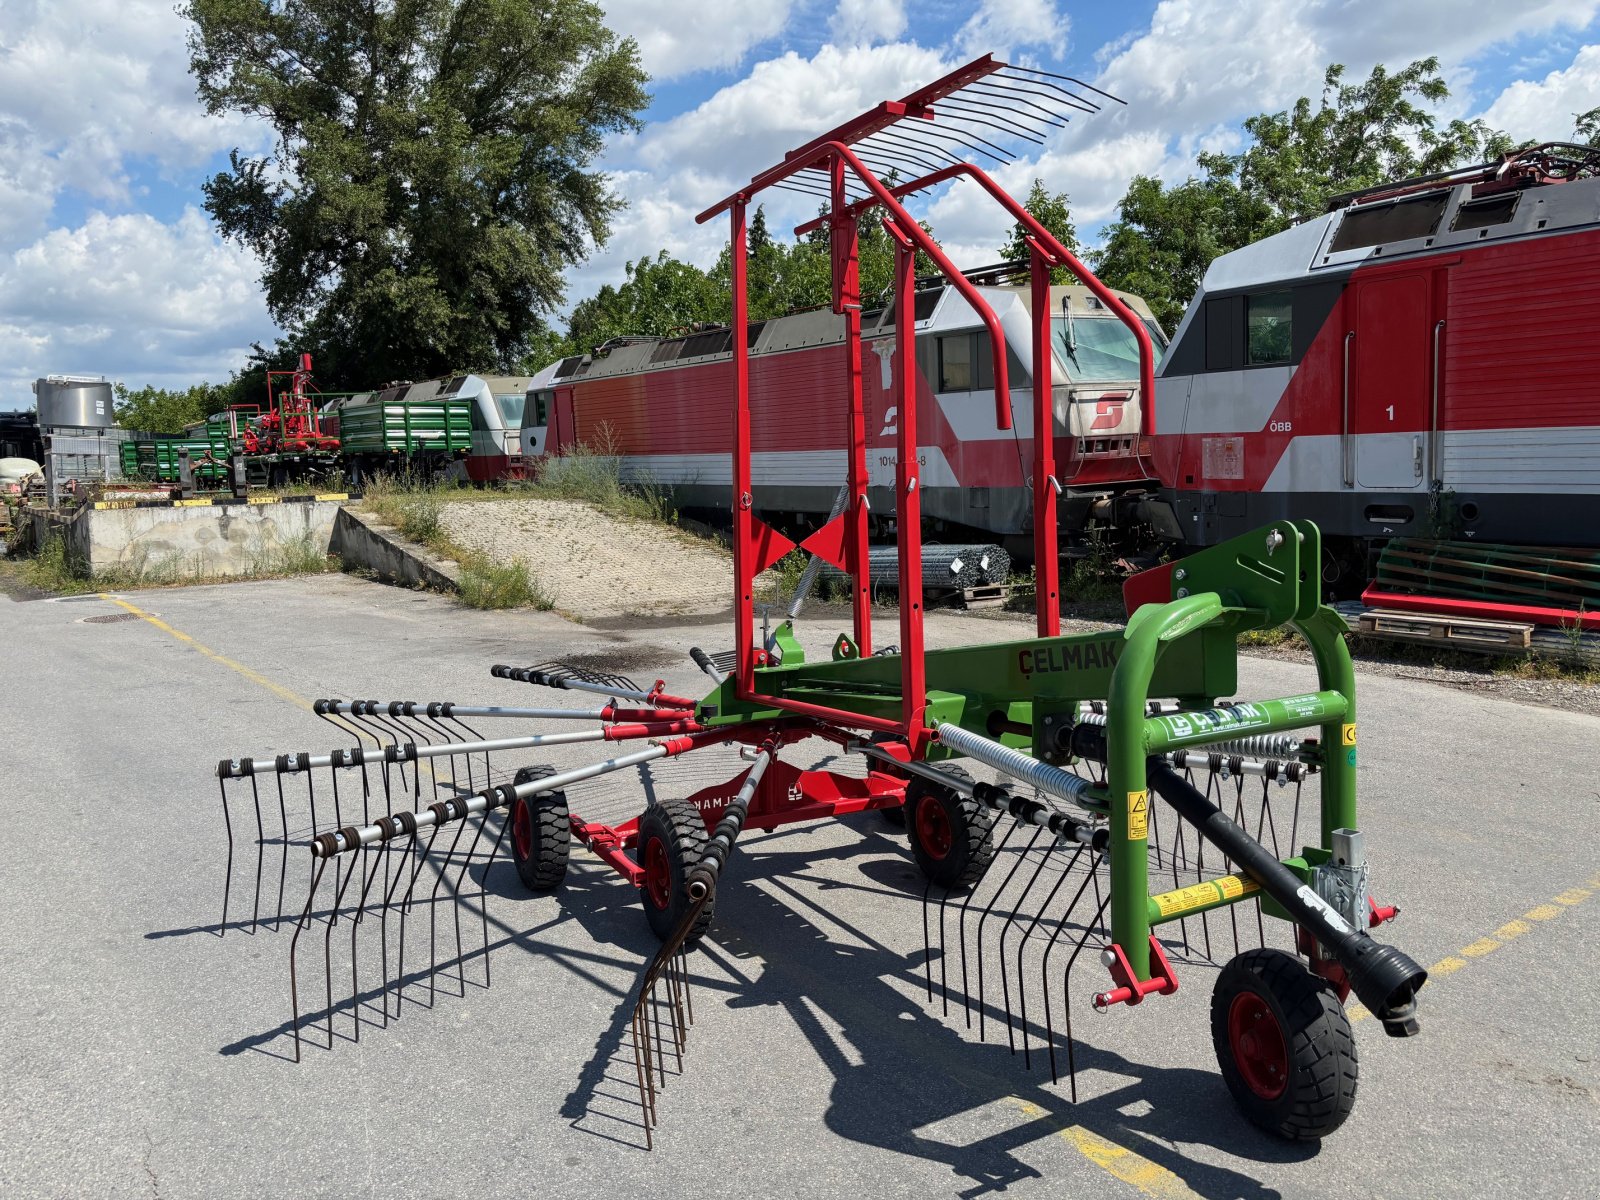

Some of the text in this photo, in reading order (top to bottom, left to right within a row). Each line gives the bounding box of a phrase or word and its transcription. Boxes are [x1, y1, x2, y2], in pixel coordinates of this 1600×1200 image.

[1385, 404, 1394, 421] 1
[1269, 420, 1292, 432] ÖBB
[879, 456, 896, 466] 1014
[1018, 640, 1118, 680] ÇELMAK
